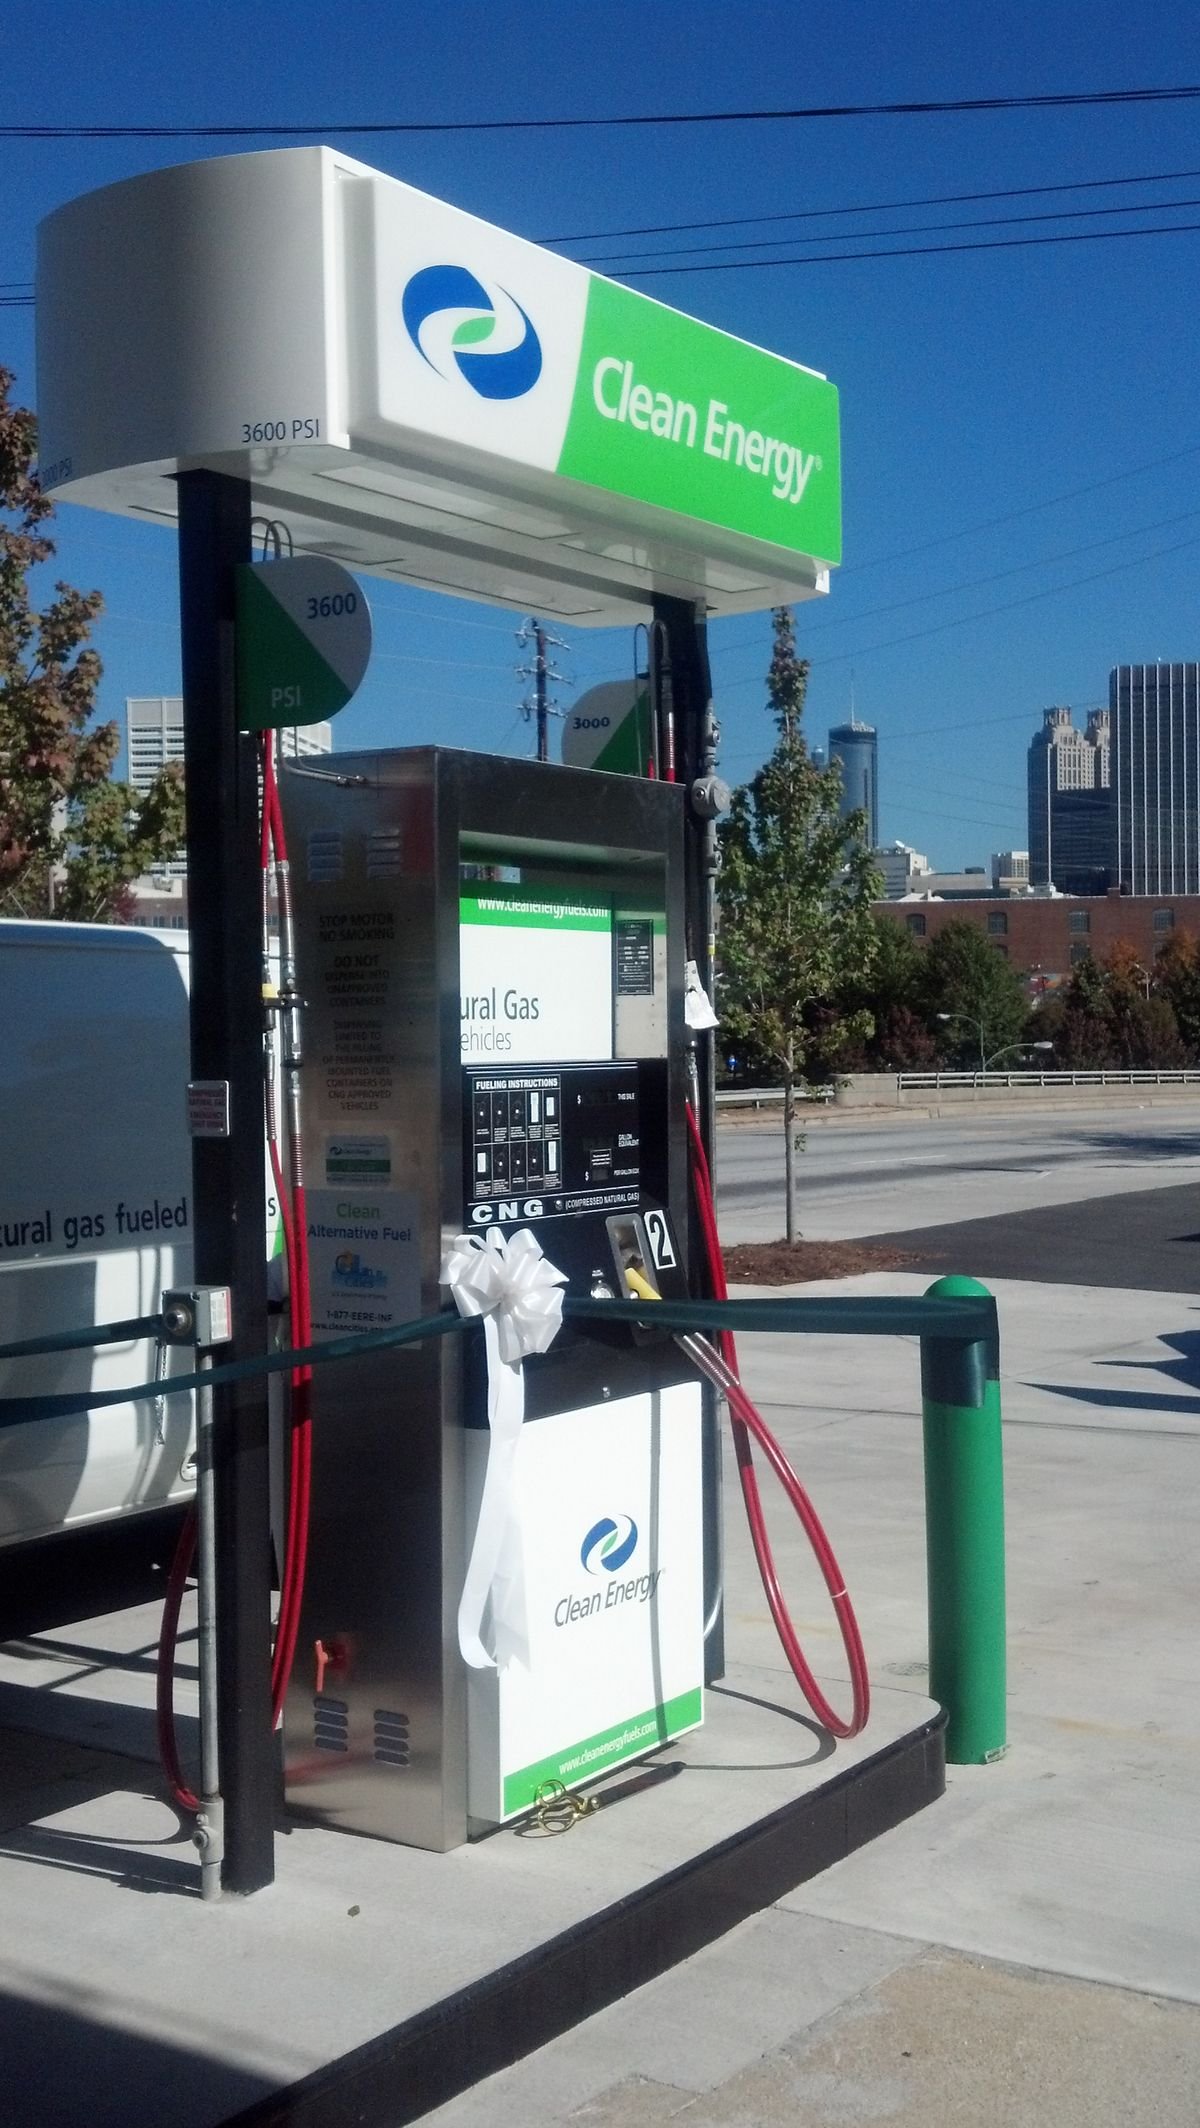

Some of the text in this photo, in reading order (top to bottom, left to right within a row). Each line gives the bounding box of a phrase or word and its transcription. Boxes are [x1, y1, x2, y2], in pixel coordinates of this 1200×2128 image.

[242, 418, 320, 443] 3600 PSI
[593, 356, 813, 505] Clean Energy
[307, 593, 357, 620] 3600
[271, 686, 301, 709] PSI
[572, 716, 610, 730] 3000
[477, 895, 608, 919] www.cleanenergyfuels.com
[319, 912, 394, 928] STOP MOTOR
[338, 926, 395, 941] SMOKING
[504, 989, 539, 1020] Gas
[476, 1078, 558, 1090] FUELING INSTRUCTIONS
[577, 1095, 582, 1105] $
[585, 1171, 590, 1181] $
[336, 1202, 380, 1219] Clean
[472, 1199, 544, 1224] CNG
[64, 1213, 105, 1249] gas
[115, 1197, 188, 1236] fueled
[308, 1223, 411, 1241] Alternative Fuel
[650, 1213, 674, 1267] 2
[554, 1570, 661, 1627] Clean Energy
[559, 1721, 657, 1775] www.cleanenergyfuels.com
